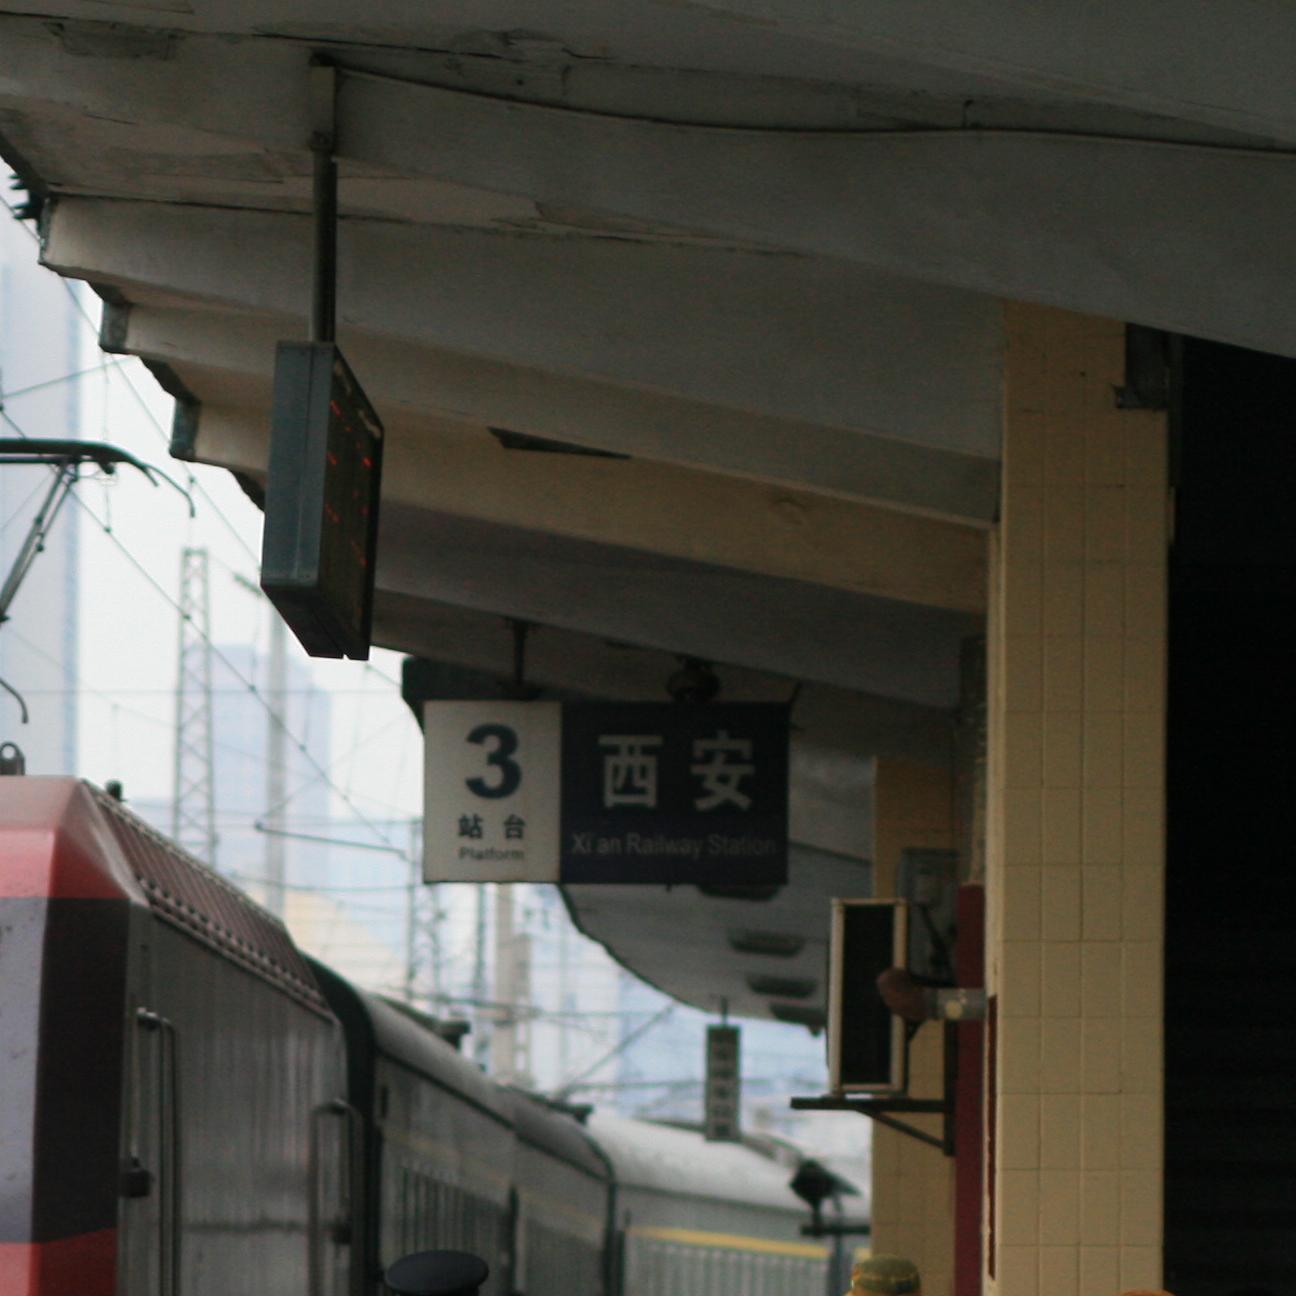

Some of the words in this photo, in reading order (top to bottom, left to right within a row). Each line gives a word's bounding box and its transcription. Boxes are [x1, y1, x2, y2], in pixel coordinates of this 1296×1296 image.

[464, 723, 522, 800] 3
[597, 730, 756, 813] 西安
[457, 813, 527, 841] 站台
[458, 845, 526, 861] Platform
[625, 832, 703, 860] Railway
[707, 833, 777, 857] Station
